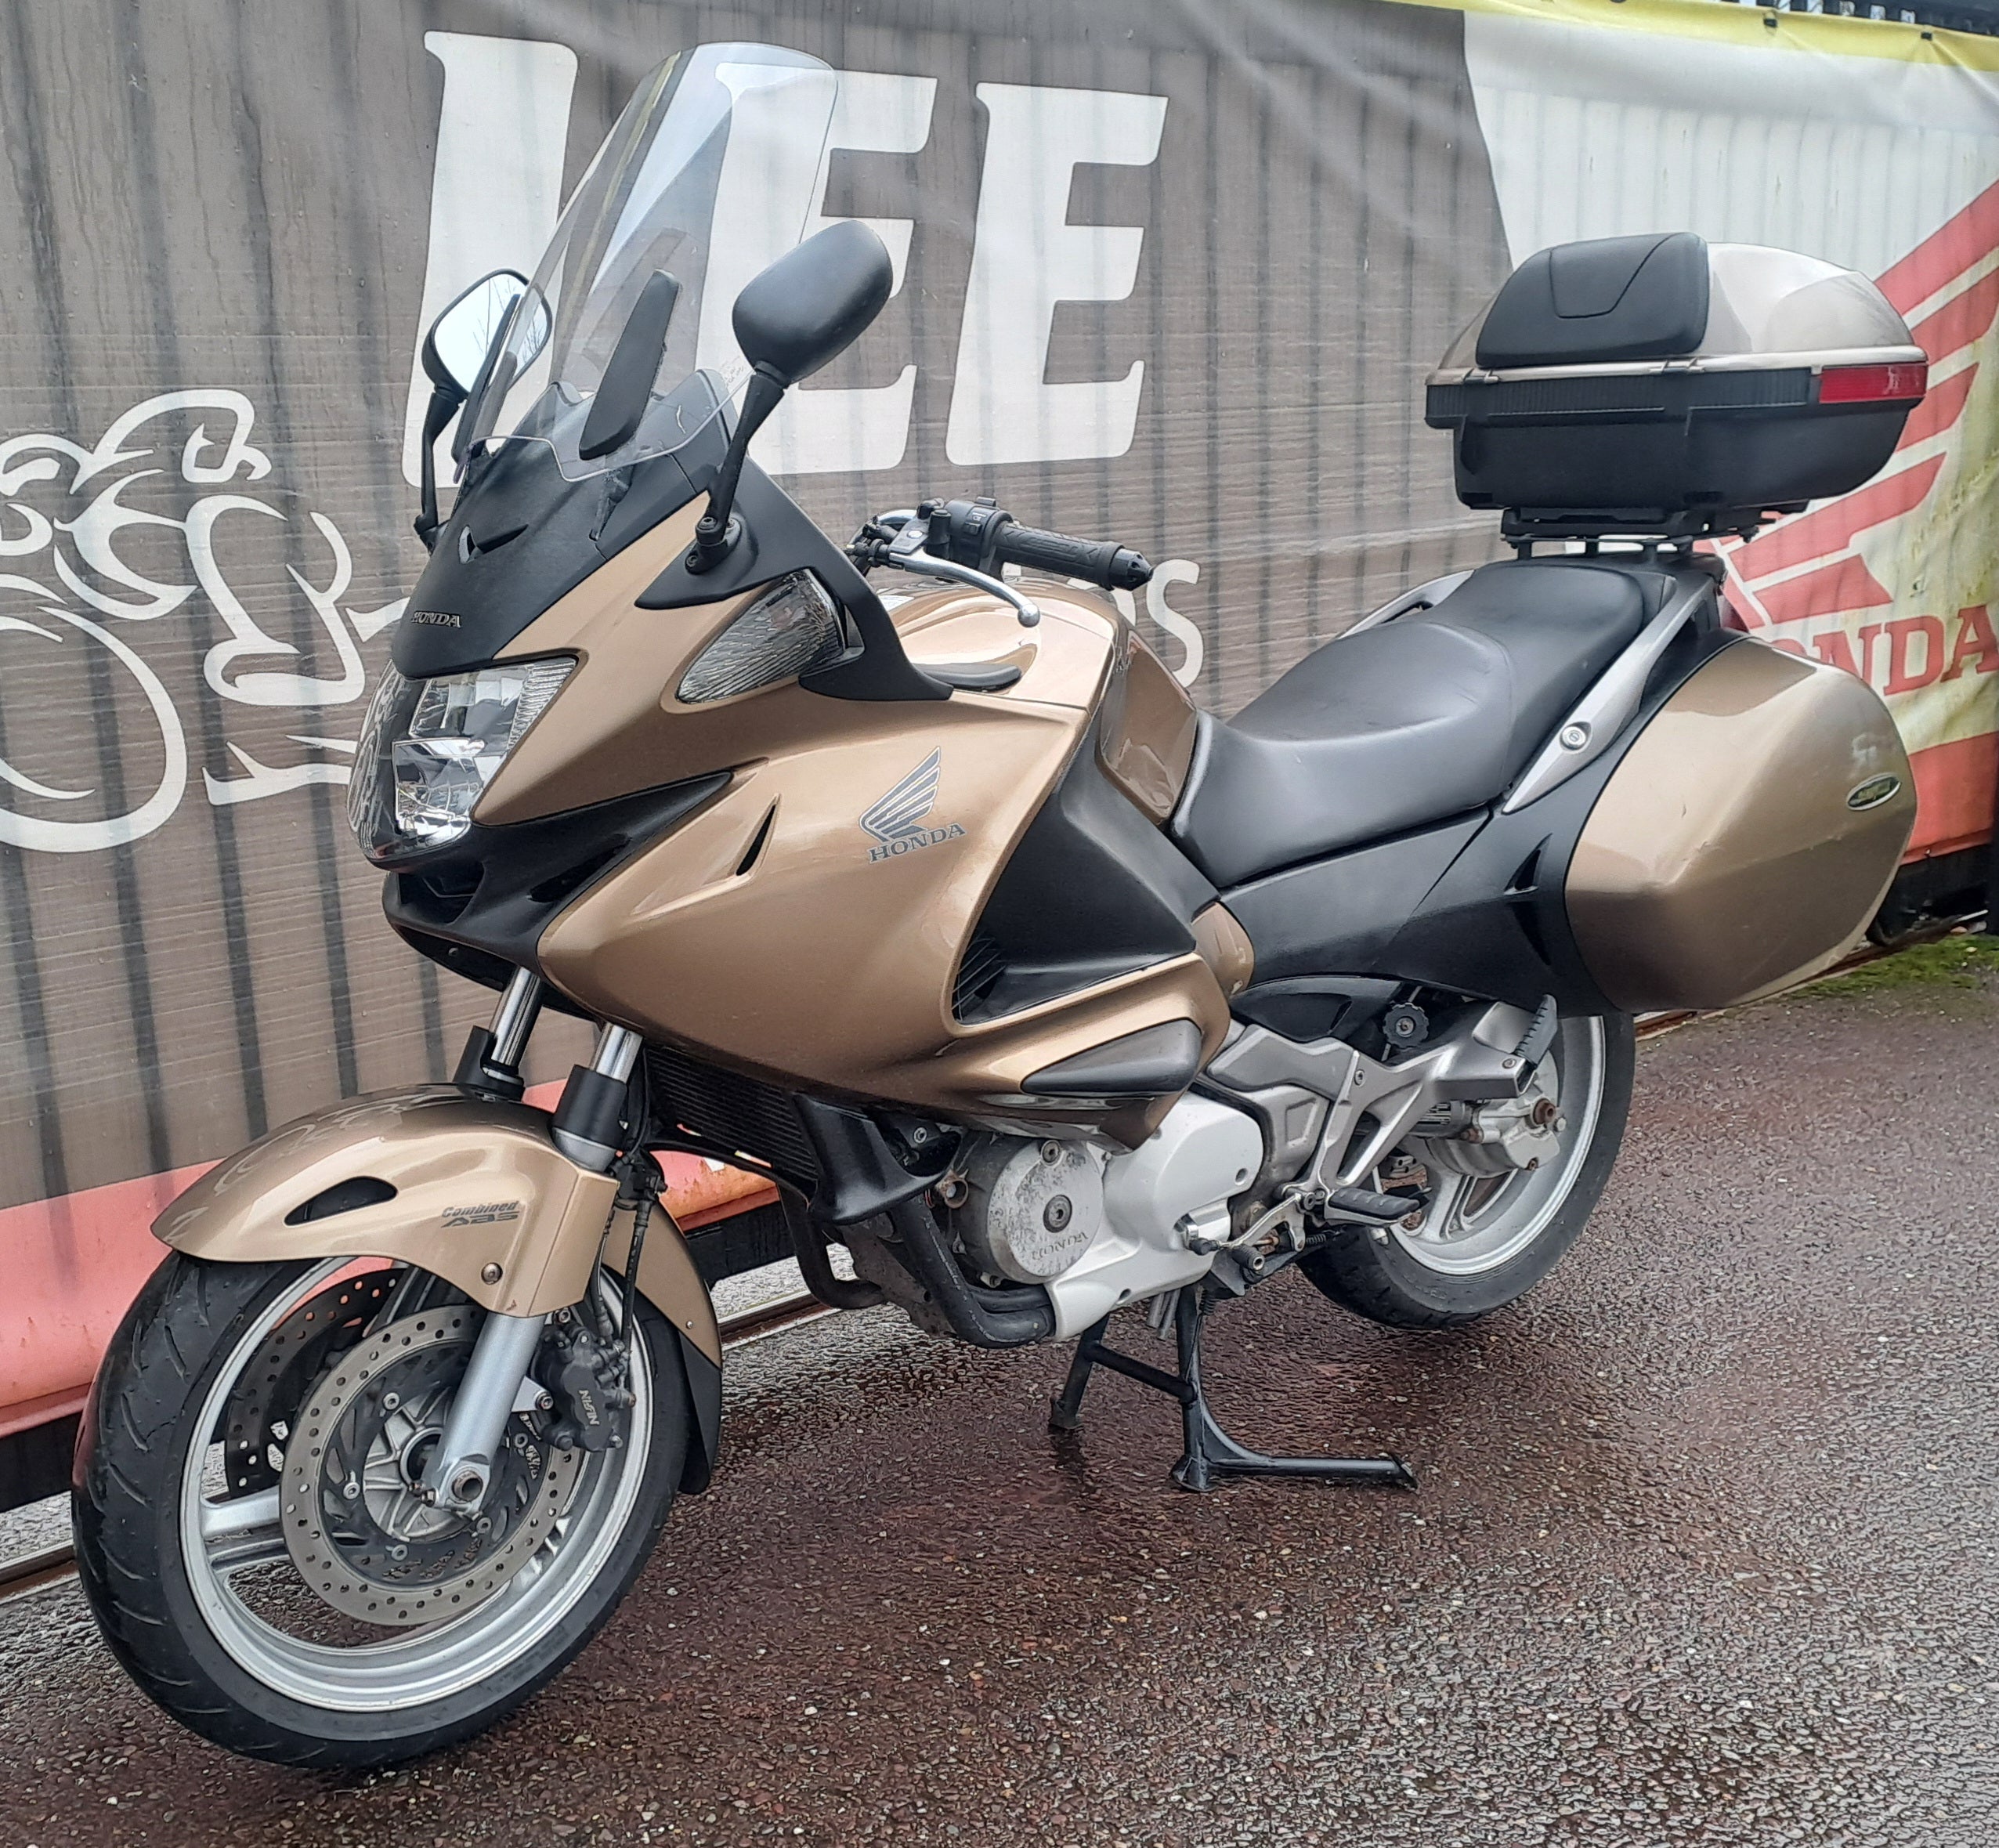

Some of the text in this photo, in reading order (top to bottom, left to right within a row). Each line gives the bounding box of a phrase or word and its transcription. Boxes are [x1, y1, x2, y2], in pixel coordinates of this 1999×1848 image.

[410, 611, 461, 628] HONDA
[1769, 604, 1999, 696] NDA
[868, 823, 967, 863] HONDA
[441, 1200, 519, 1218] Combined
[440, 1211, 520, 1228] ABS
